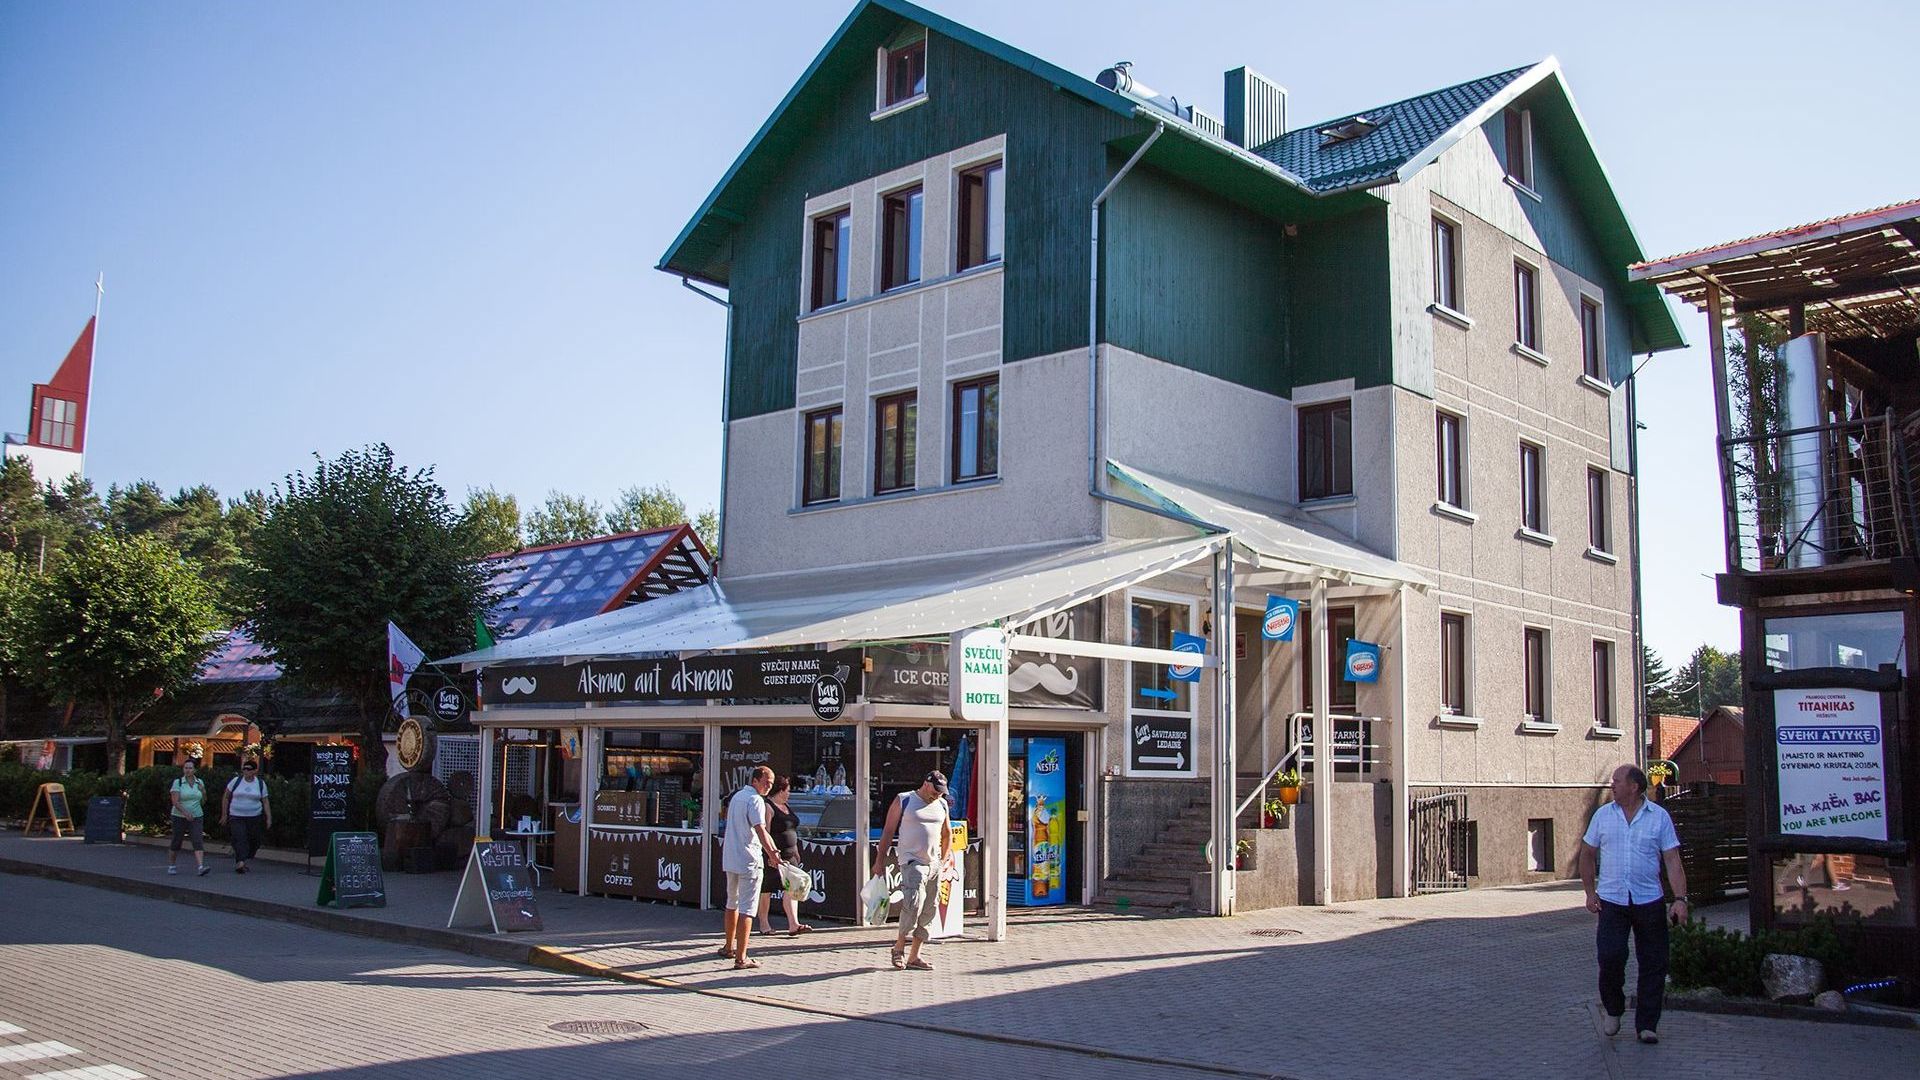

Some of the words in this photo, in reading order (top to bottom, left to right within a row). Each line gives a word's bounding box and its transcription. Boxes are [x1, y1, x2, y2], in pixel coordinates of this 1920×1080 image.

[761, 659, 790, 672] SVEČIŲ
[792, 659, 820, 671] NAMAI
[964, 661, 1003, 675] NAMAI
[577, 664, 626, 694] Akmuo
[634, 662, 662, 695] ant
[671, 661, 734, 693] akmens
[763, 674, 788, 685] GUEST
[790, 673, 817, 685] HOUSE
[893, 669, 918, 685] ICE
[921, 670, 949, 687] CRE
[965, 693, 1003, 704] HOTEL
[1798, 701, 1855, 711] TITANIKAS
[1333, 730, 1366, 740] TARNOS
[1779, 730, 1819, 741] SVEIKI
[1785, 752, 1815, 760] MAISTO
[1816, 751, 1825, 759] IR
[1826, 751, 1865, 759] NAKTINIO
[1036, 762, 1060, 773] NESTEA
[1780, 761, 1821, 770] GYVENIMO
[1783, 803, 1807, 815] Мы
[1853, 790, 1881, 805] ВАС
[1782, 820, 1802, 831] YOU
[1805, 817, 1827, 827] ARE
[1829, 809, 1882, 825] WELCOME
[658, 856, 682, 881] Rapi
[604, 874, 634, 886] COFFEE
[885, 863, 903, 890] Ra
